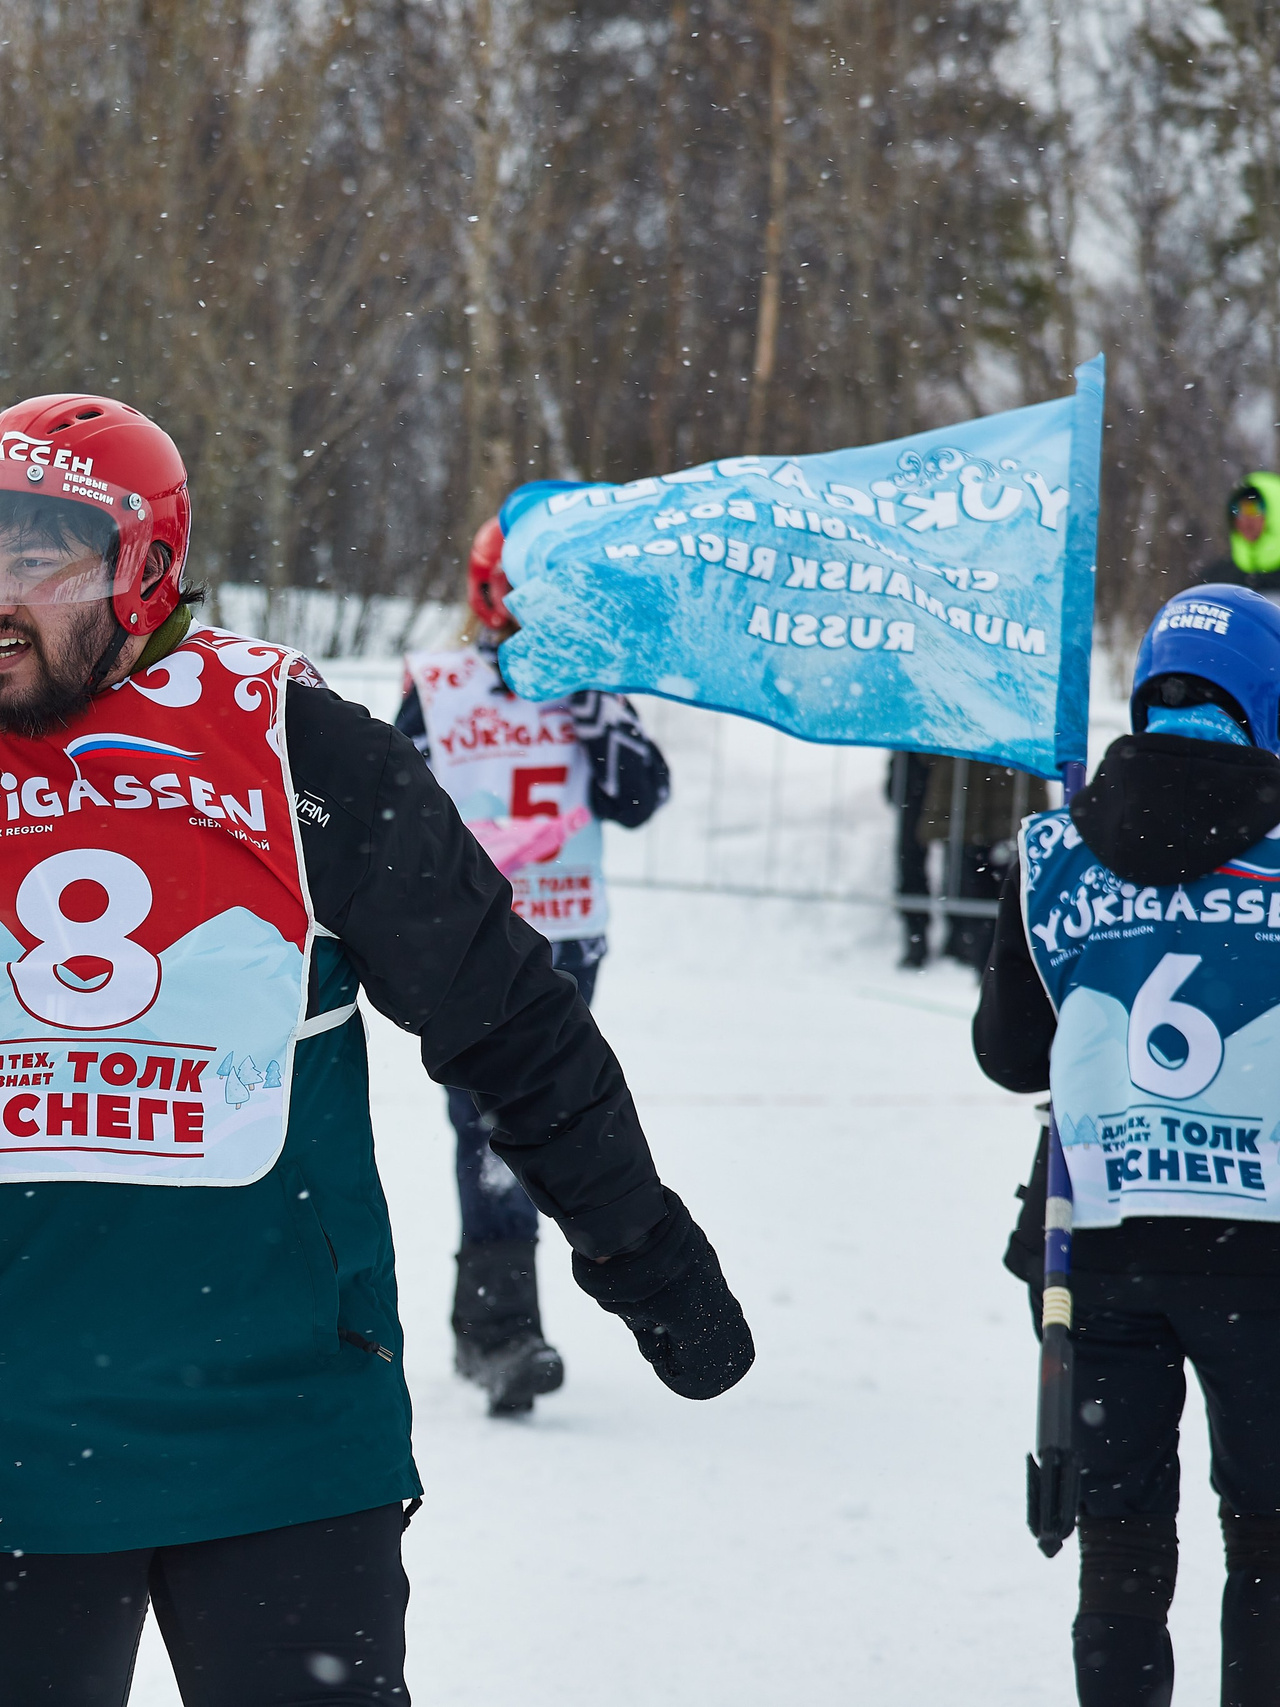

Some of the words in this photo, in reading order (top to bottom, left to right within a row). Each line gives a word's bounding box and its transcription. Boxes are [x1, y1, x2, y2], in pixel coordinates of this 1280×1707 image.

[62, 483, 70, 492] В
[72, 485, 114, 506] РОССИИ
[64, 472, 108, 492] ПЕРВЫЕ
[1169, 614, 1229, 636] СНЕГЕ
[6, 824, 53, 837] REGION
[511, 766, 568, 863] 5
[7, 848, 162, 1031] 8
[1126, 951, 1224, 1100] 6
[8, 1052, 55, 1069] ТЕХ,
[67, 1051, 210, 1093] ТОЛК
[2, 1092, 205, 1143] СНЕГЕ
[1160, 1116, 1261, 1155] ТОЛК
[1122, 1148, 1266, 1191] СНЕГЕ
